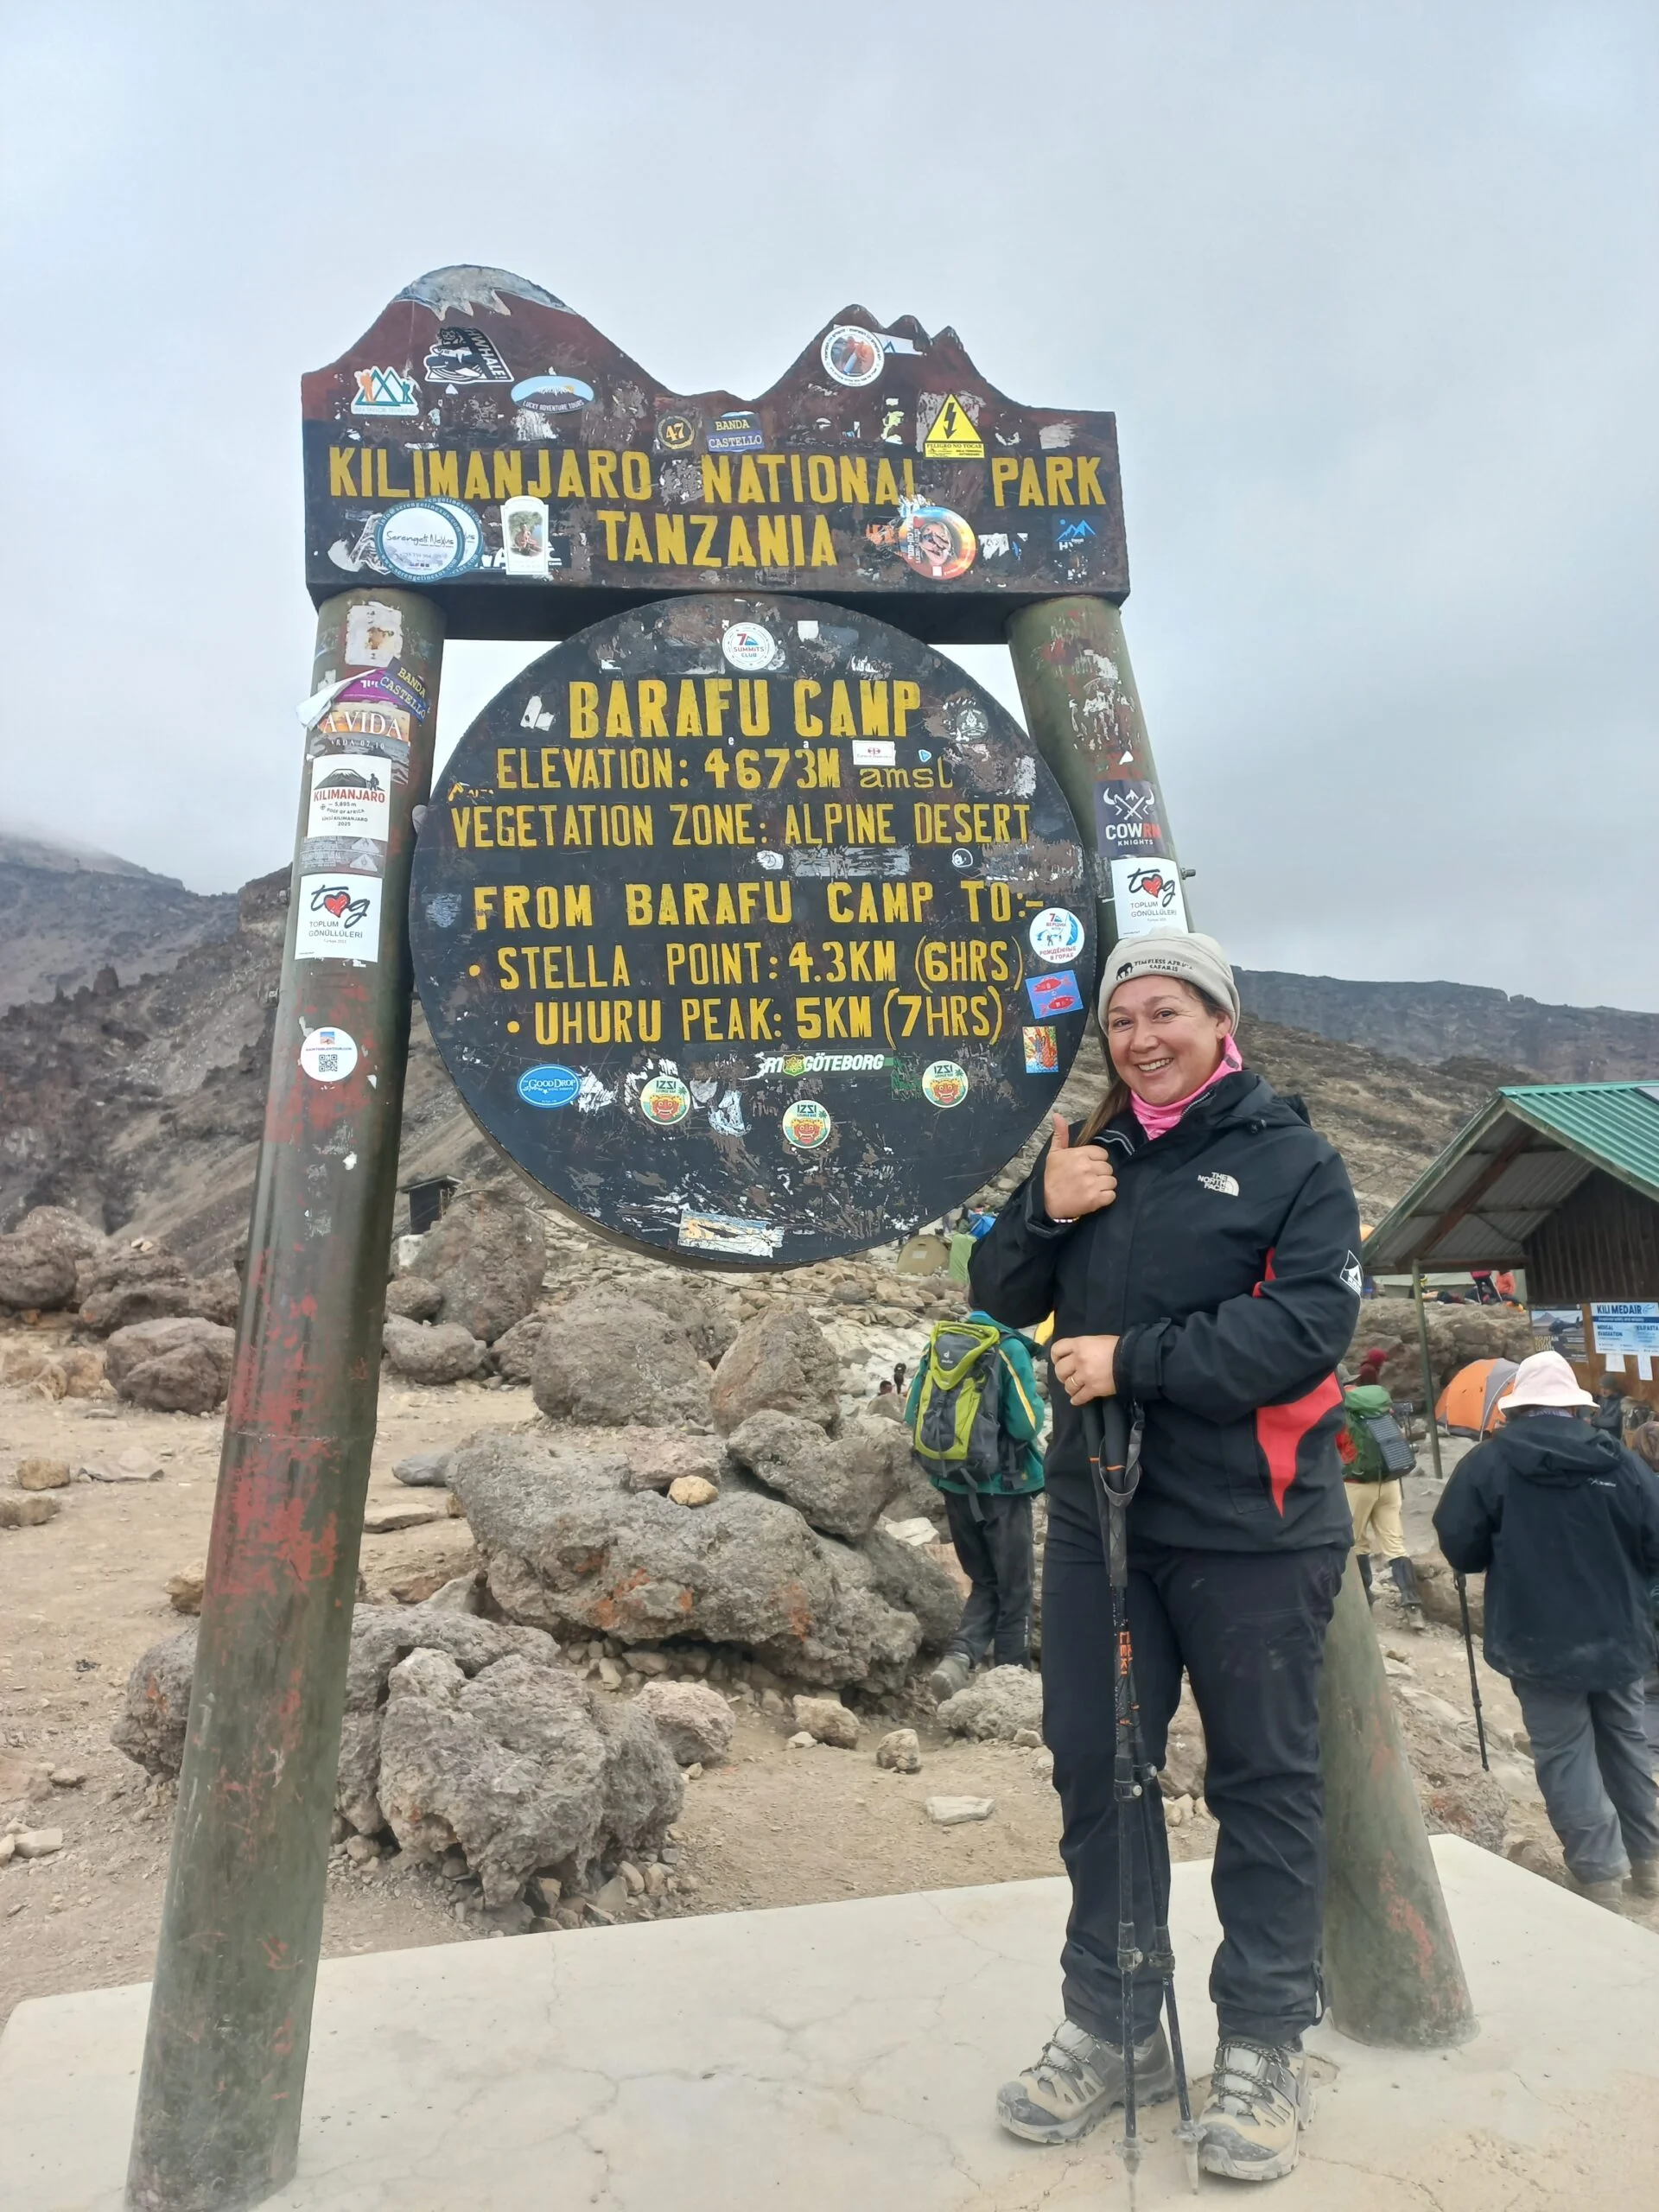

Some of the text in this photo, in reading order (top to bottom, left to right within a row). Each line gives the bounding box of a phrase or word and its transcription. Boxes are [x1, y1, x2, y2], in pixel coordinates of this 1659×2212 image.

[539, 404, 568, 412] ADVENTURE
[568, 400, 584, 411] TOURS
[665, 422, 685, 442] 47
[715, 419, 750, 431] BANDA
[709, 435, 762, 448] CASTELLO
[328, 446, 652, 501] KILIMANJARO
[991, 456, 1107, 507] PARK
[596, 510, 837, 568] TANZANIA
[736, 632, 747, 646] 7
[397, 666, 427, 699] BANDA
[379, 676, 427, 719] CASTELLO
[569, 678, 770, 740] BARAFU
[793, 678, 921, 738] CAMP
[343, 711, 404, 741] VIDA
[496, 747, 954, 790] ELEVATION: 4673M amsl
[314, 788, 385, 804] KILIMANJARO
[451, 803, 1031, 848] VEGETATION ZONE: ALPINE DESERT
[474, 884, 594, 931] FROM
[625, 880, 793, 926] BARAFU
[826, 880, 933, 924] CAMP
[1049, 912, 1056, 922] 7
[497, 935, 1024, 994] STELLA POINT: 4.3KM (6HRS)
[534, 985, 1002, 1050] UHURU PEAK: 5KM (7HRS)
[804, 1052, 885, 1071] GÖTEBORG
[1197, 1174, 1225, 1187] NORTH
[1204, 1182, 1225, 1192] FACE
[1211, 1172, 1227, 1181] THE
